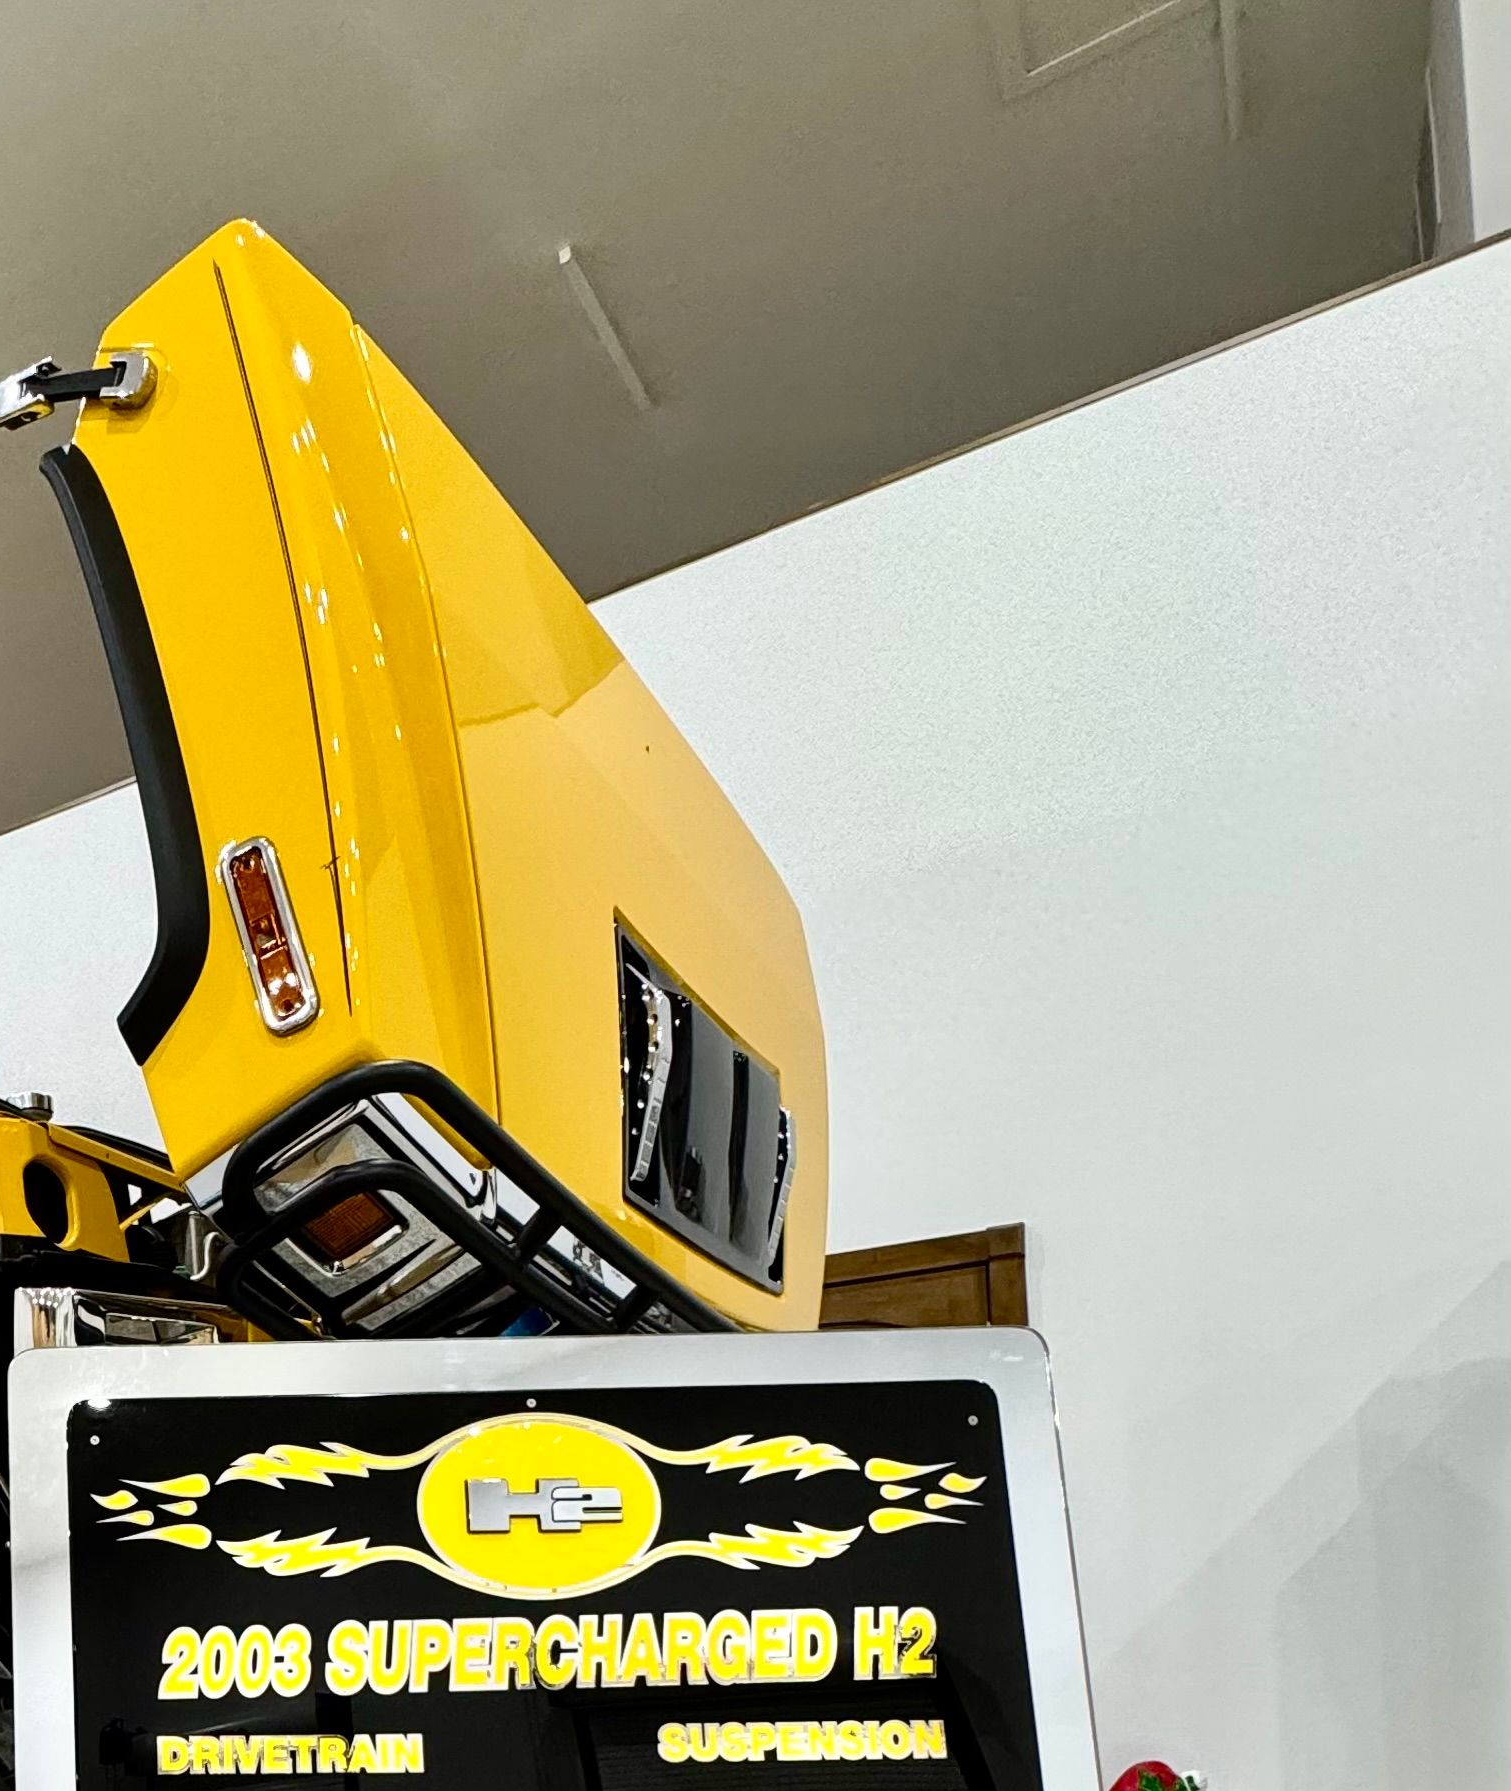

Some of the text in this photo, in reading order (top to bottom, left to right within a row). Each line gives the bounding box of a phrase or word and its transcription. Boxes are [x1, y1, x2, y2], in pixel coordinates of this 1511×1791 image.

[464, 1477, 624, 1534] H2
[158, 1606, 938, 1699] 2003 SUPERCHARGED H2
[156, 1733, 424, 1775] DRIVETRAIN
[657, 1719, 947, 1763] SUSPENSION
